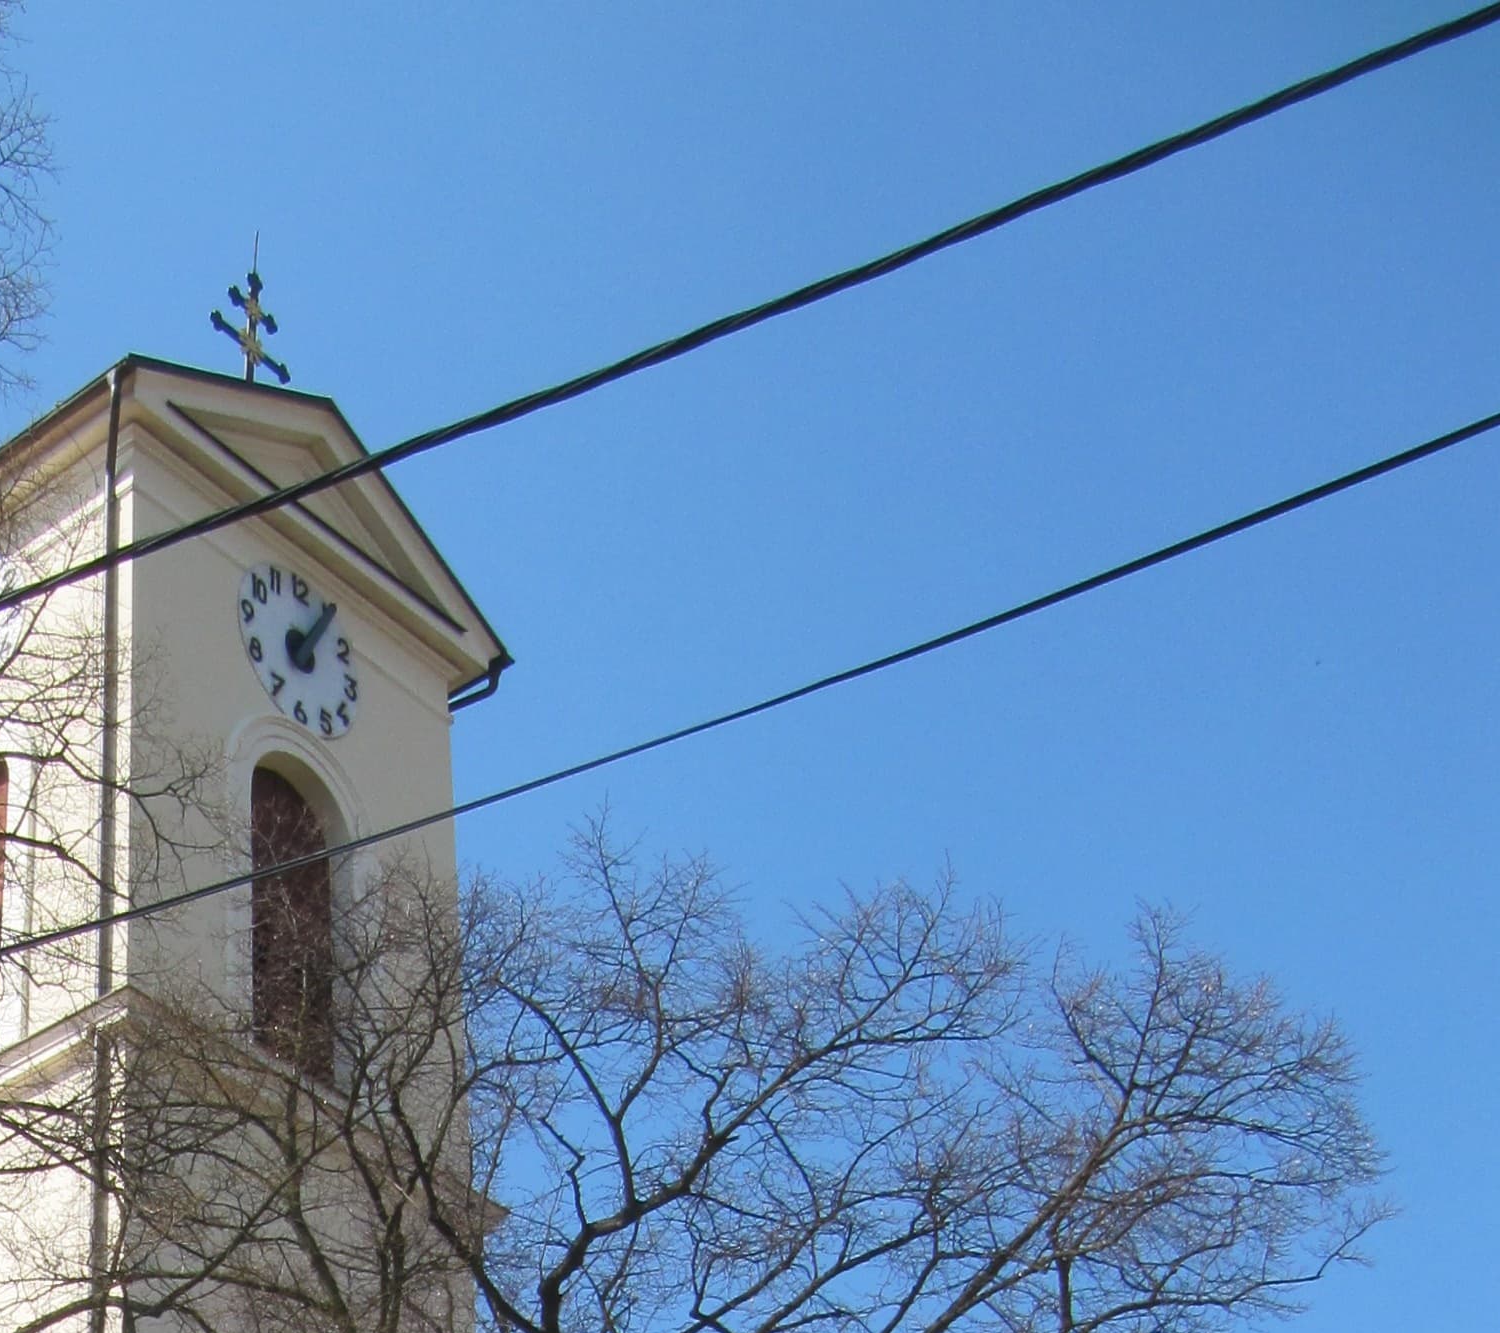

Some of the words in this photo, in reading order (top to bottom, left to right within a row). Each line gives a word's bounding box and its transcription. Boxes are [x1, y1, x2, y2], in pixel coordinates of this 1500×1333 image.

[252, 572, 268, 604] 10
[269, 566, 281, 596] 11
[292, 574, 310, 606] 12
[241, 599, 254, 624] 9
[249, 636, 262, 663] 8
[337, 638, 350, 665] 2
[270, 672, 285, 697] 7
[344, 674, 357, 701] 3
[294, 700, 307, 725] 6
[320, 709, 333, 735] 5
[336, 702, 350, 727] 4
